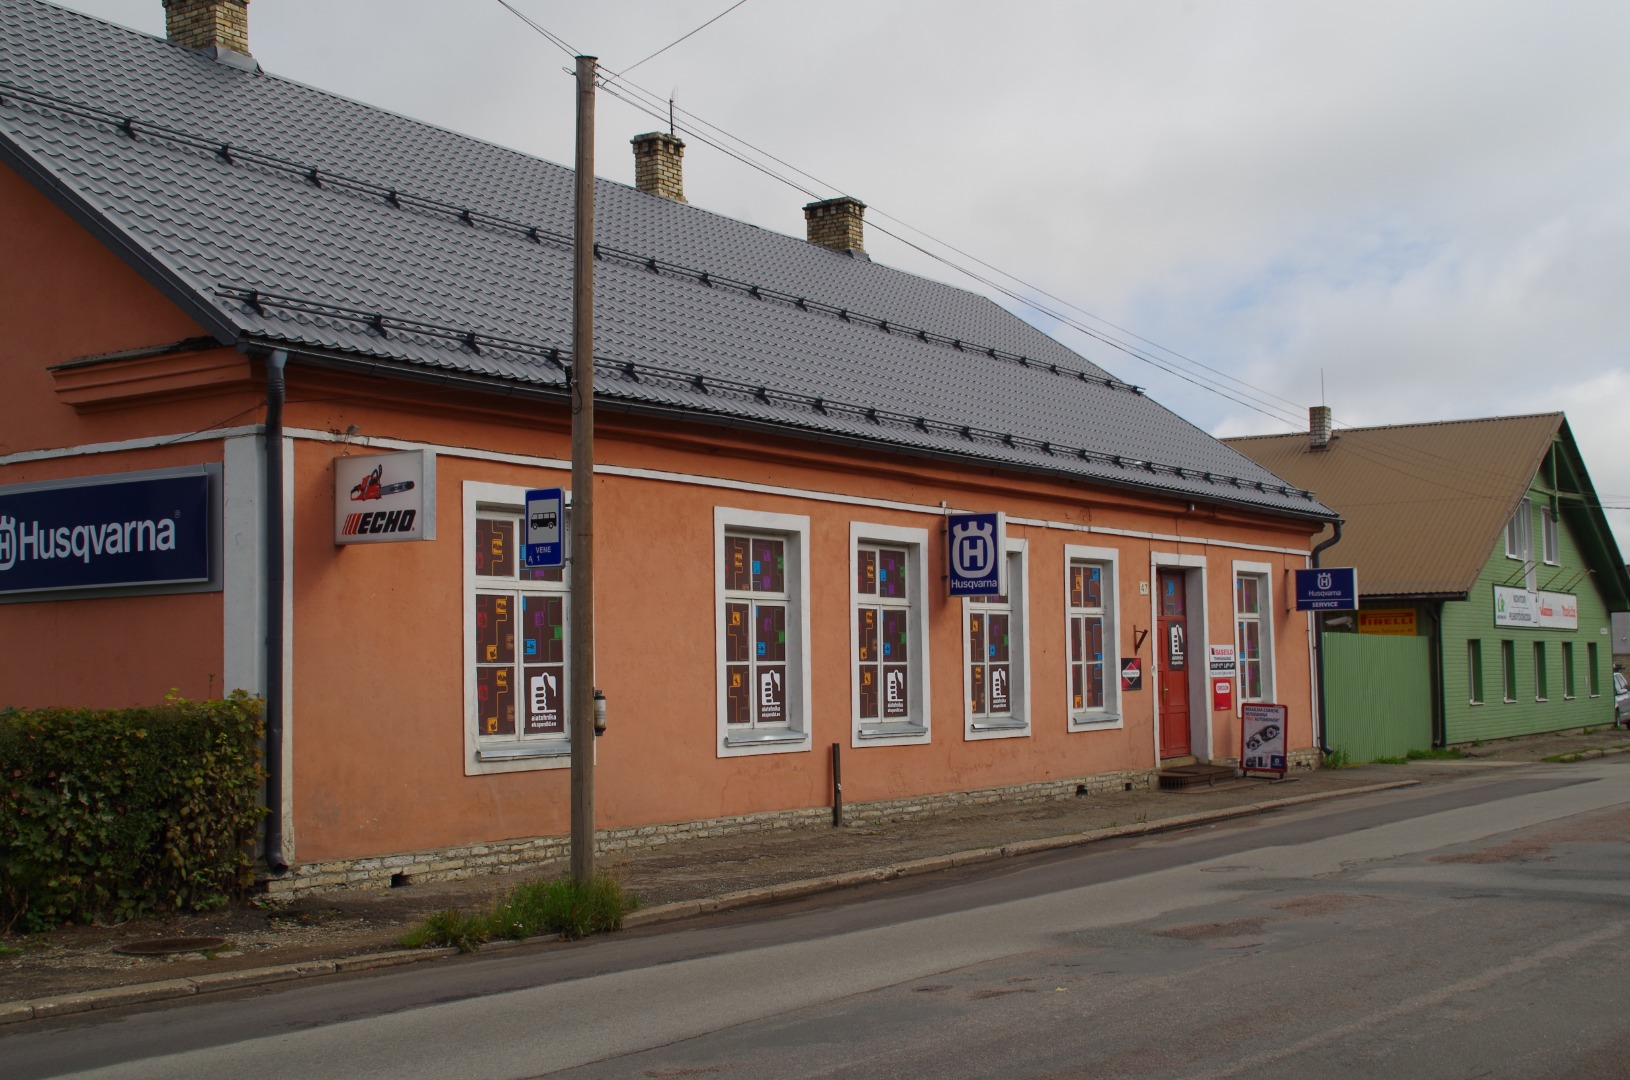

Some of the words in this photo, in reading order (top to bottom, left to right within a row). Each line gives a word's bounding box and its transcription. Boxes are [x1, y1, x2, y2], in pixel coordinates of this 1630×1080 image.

[357, 509, 416, 534] ECHO
[19, 518, 176, 564] Husqvarna
[535, 546, 552, 554] VENE
[951, 579, 998, 589] Husqvarna
[1140, 583, 1148, 592] 47
[1360, 612, 1414, 626] PIRELLI
